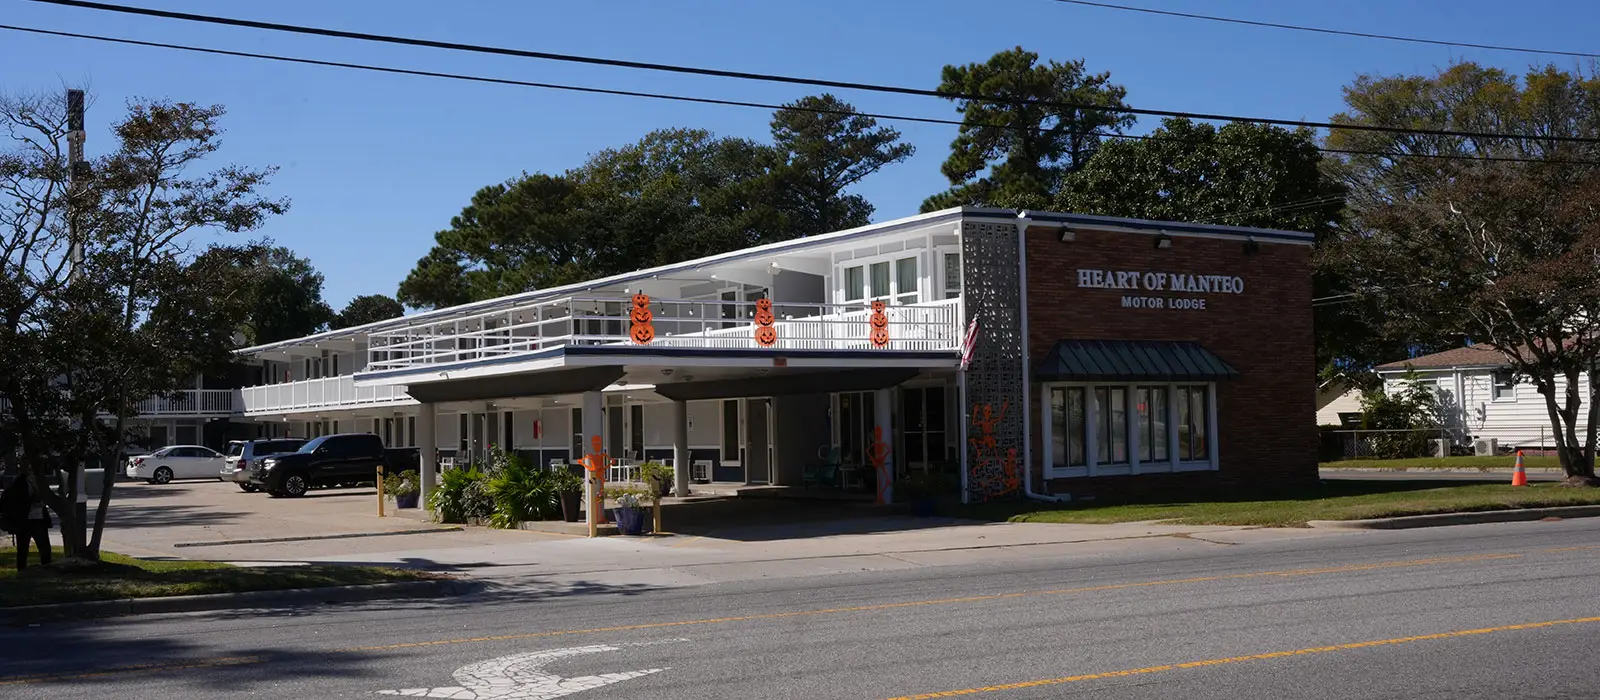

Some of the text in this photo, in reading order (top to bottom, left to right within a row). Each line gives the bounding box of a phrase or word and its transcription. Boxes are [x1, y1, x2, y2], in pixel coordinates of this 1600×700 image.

[1077, 269, 1244, 294] HEART OF MANTEO
[1121, 296, 1206, 310] MOTOR LODGE
